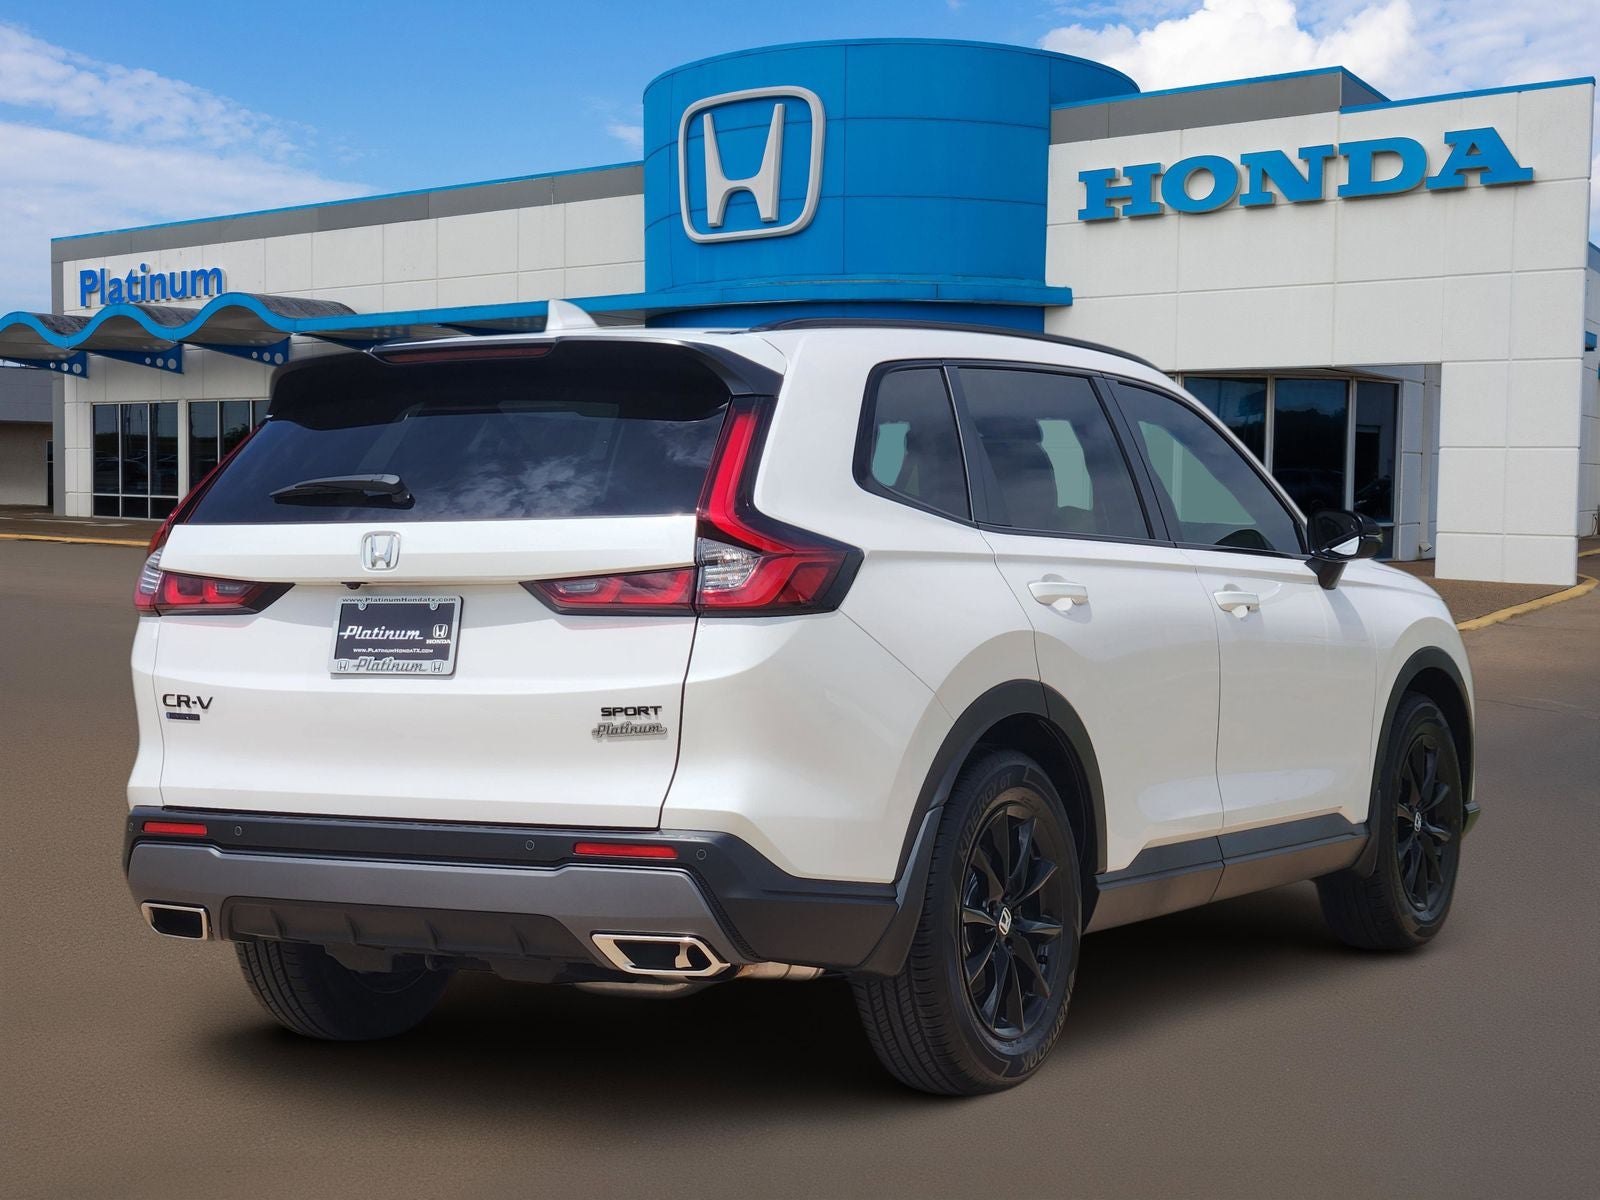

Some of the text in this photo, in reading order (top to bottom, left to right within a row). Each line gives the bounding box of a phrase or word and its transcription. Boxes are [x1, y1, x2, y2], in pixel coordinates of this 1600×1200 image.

[1078, 127, 1534, 221] HONDA
[79, 263, 225, 308] Platinum
[339, 625, 424, 640] Platinum
[351, 656, 427, 672] Platinum
[162, 693, 213, 710] CR-V
[600, 705, 662, 717] SPORT
[591, 721, 668, 738] Platinum
